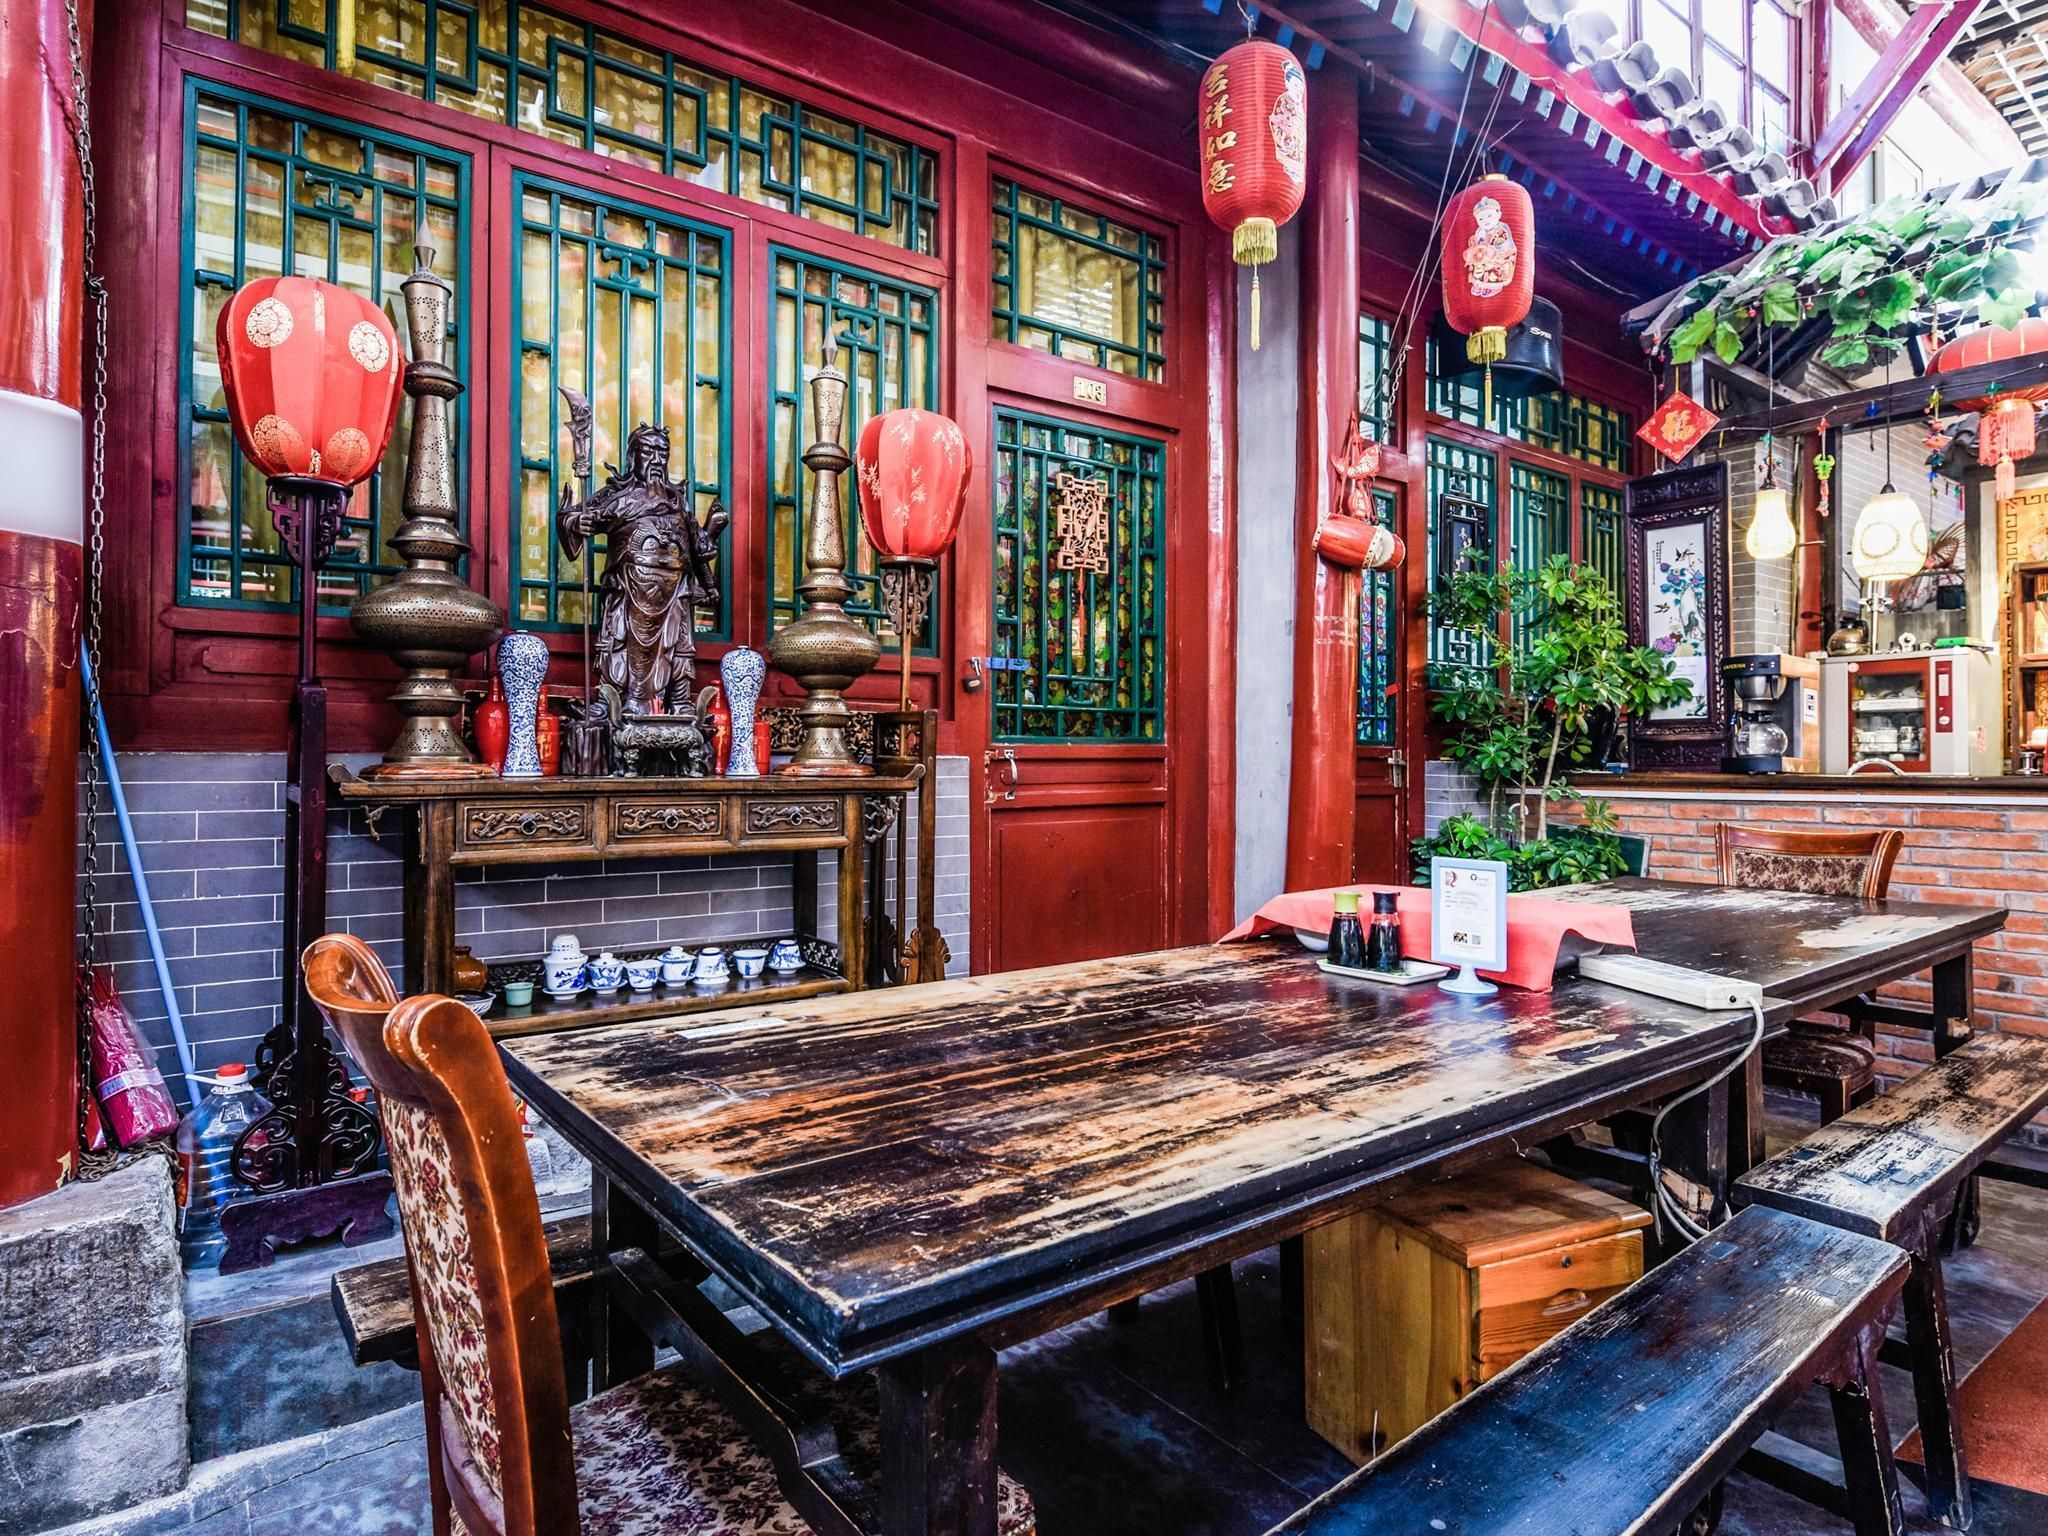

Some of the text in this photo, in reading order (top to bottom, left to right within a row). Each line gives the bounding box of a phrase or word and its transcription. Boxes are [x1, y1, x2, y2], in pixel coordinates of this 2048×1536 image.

[1204, 63, 1237, 195] 吉祥如意
[1660, 409, 1697, 444] 福
